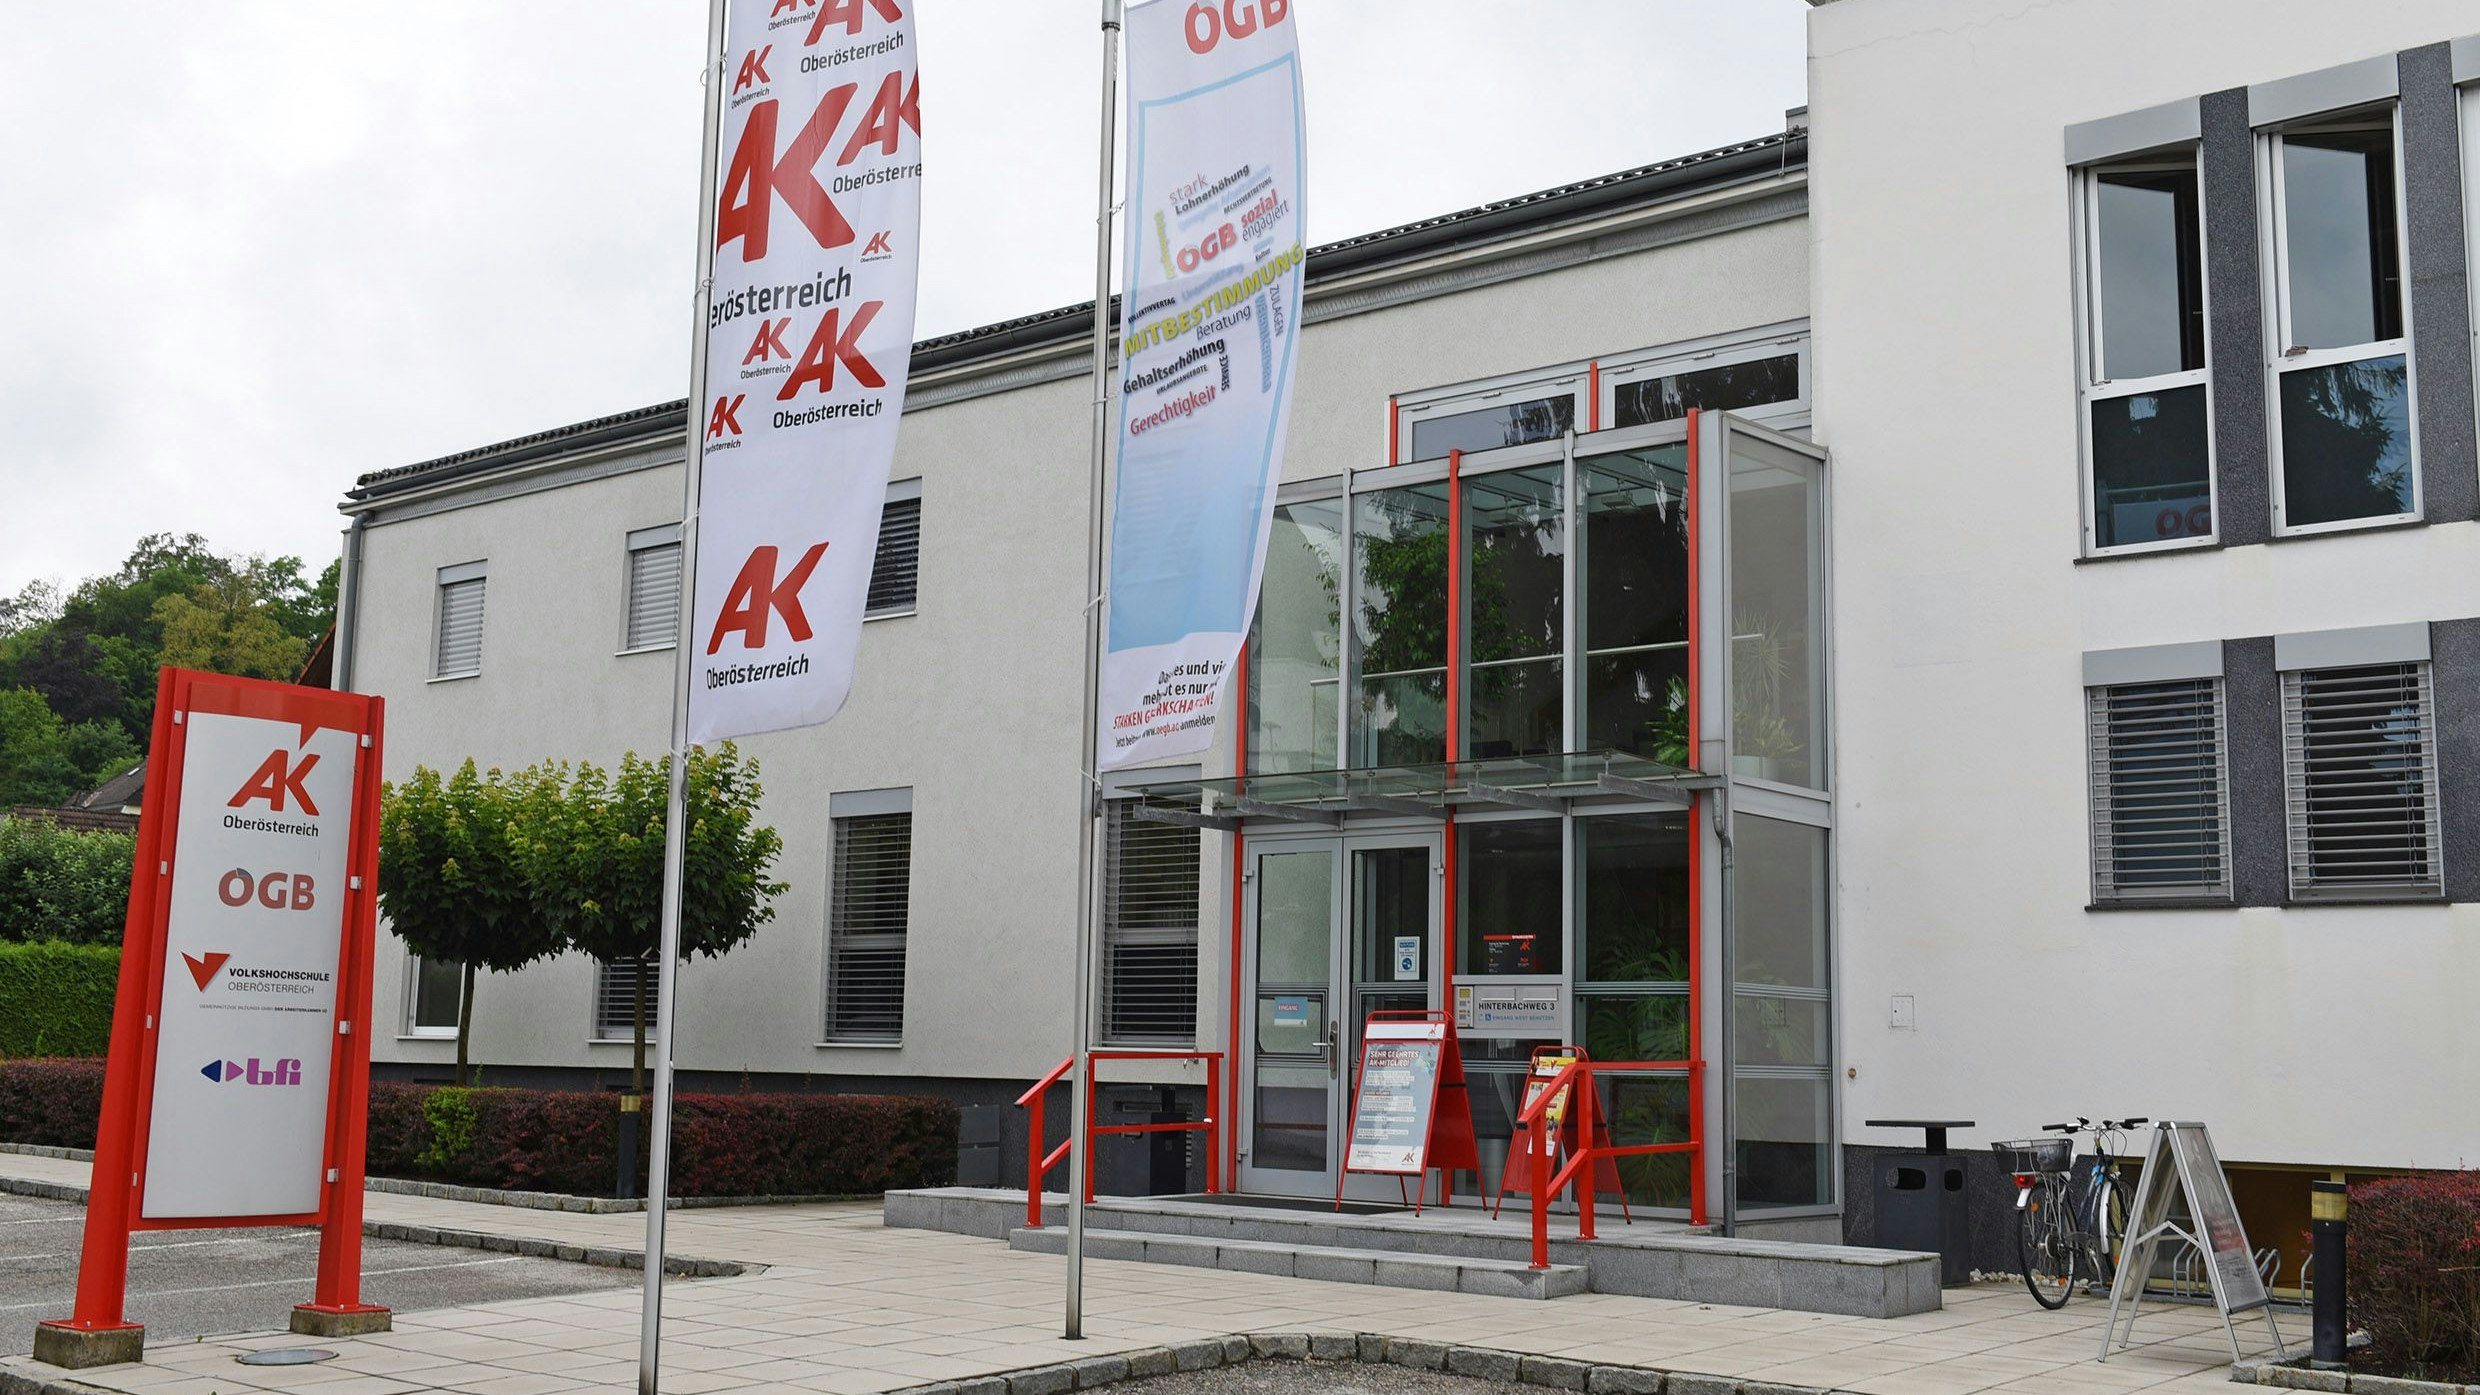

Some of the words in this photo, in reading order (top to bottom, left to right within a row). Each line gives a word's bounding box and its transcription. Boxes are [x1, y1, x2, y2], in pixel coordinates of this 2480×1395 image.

[733, 44, 773, 96] AK
[800, 31, 903, 73] Oberösterreich
[716, 82, 859, 263] AK
[1169, 172, 1209, 205] stark
[1175, 164, 1250, 215] Lohnerhöhung
[1241, 188, 1279, 229] sozial
[1242, 200, 1289, 242] engagiert
[861, 230, 892, 256] AK
[1123, 240, 1304, 360] MITBESTIMMUNG
[742, 317, 792, 366] AK
[1196, 304, 1251, 342] Beratung
[776, 300, 886, 401] AK
[1123, 338, 1225, 395] Gehaltserhöhung
[740, 363, 791, 380] Oberösterreich
[706, 394, 746, 442] AK
[773, 398, 882, 429] Oberösterreich
[1130, 384, 1216, 436] Gerechtigkeit
[707, 541, 830, 656] AK
[706, 653, 809, 690] Oberösterreich
[1186, 660, 1209, 675] und
[1174, 685, 1186, 696] es
[1188, 683, 1208, 695] nur
[1180, 715, 1216, 730] anmelden
[226, 749, 321, 816] AK
[223, 814, 319, 837] Oberösterreich
[228, 981, 314, 994] OBERÖSTERREICH
[229, 968, 330, 982] VOLKSHOCHSCHULE
[1478, 1002, 1547, 1011] HINTERBACHWEG
[1549, 1002, 1555, 1011] 3
[246, 1058, 301, 1085] bfi
[1370, 1050, 1387, 1058] SEHR
[1402, 1152, 1414, 1163] AK
